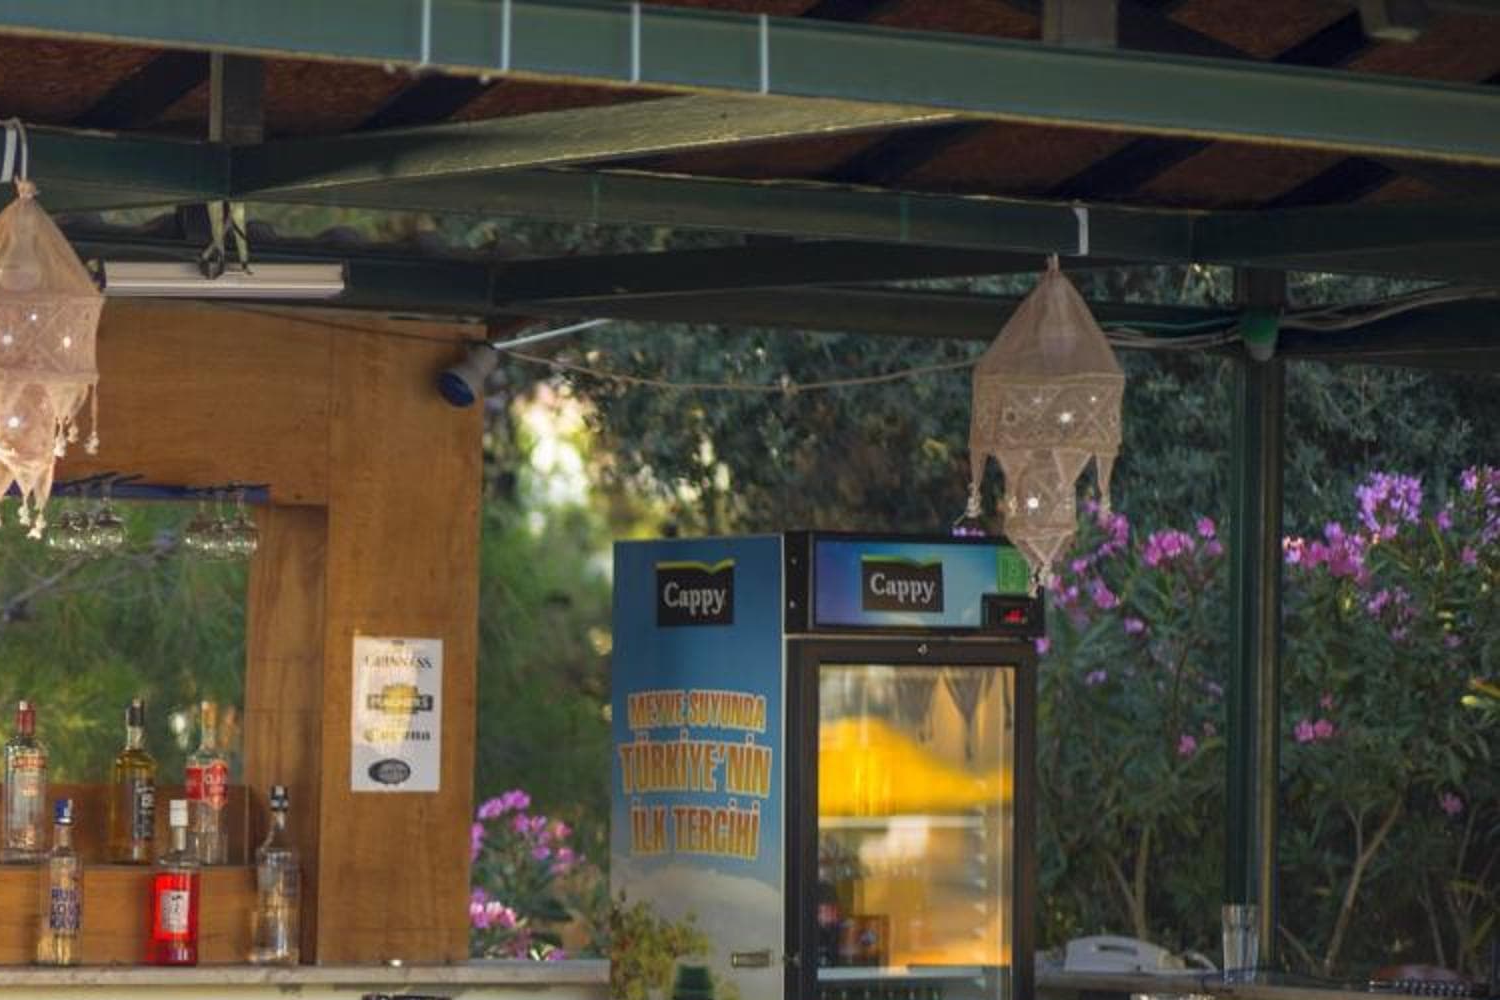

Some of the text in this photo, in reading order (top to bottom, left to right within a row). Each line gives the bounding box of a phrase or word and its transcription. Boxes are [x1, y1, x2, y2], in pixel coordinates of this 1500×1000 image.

[663, 582, 727, 615] Cappy
[869, 573, 936, 604] Cappy
[618, 730, 773, 799] TÜRKİYE'NİN
[671, 797, 761, 861] TERCİHİ
